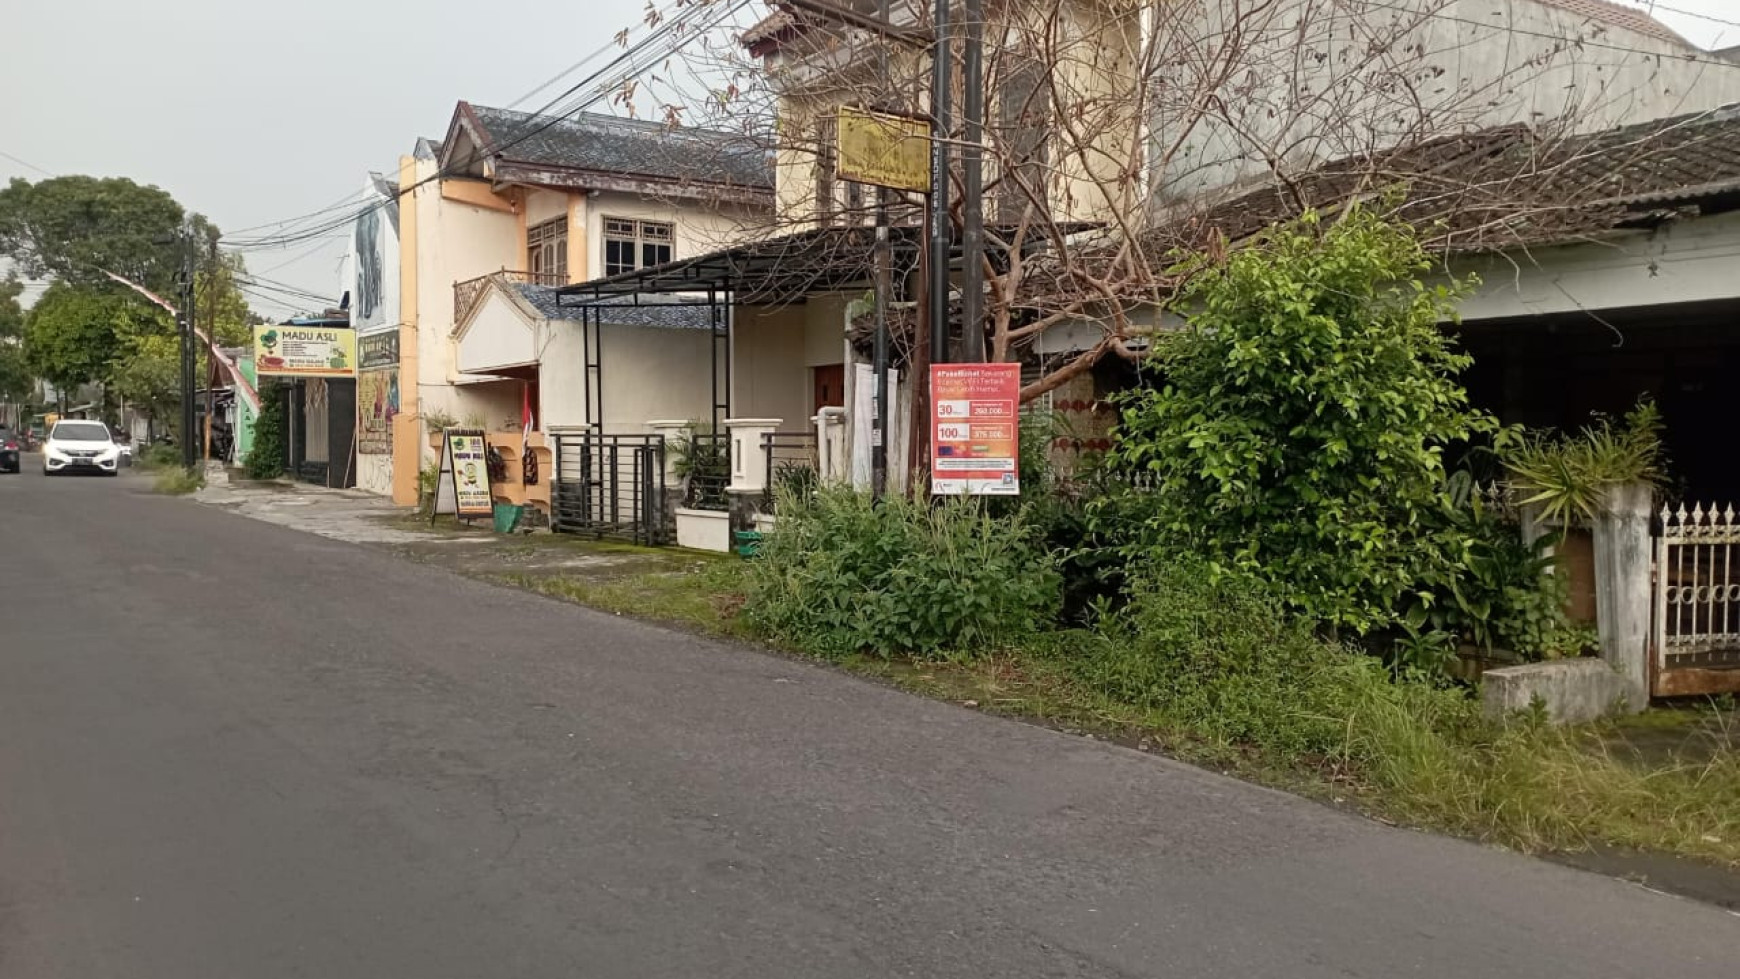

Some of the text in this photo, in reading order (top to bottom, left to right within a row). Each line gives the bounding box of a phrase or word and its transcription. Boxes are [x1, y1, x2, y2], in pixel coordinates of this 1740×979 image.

[282, 331, 338, 342] MADU ASLI
[939, 404, 952, 415] 30
[939, 428, 958, 439] 100
